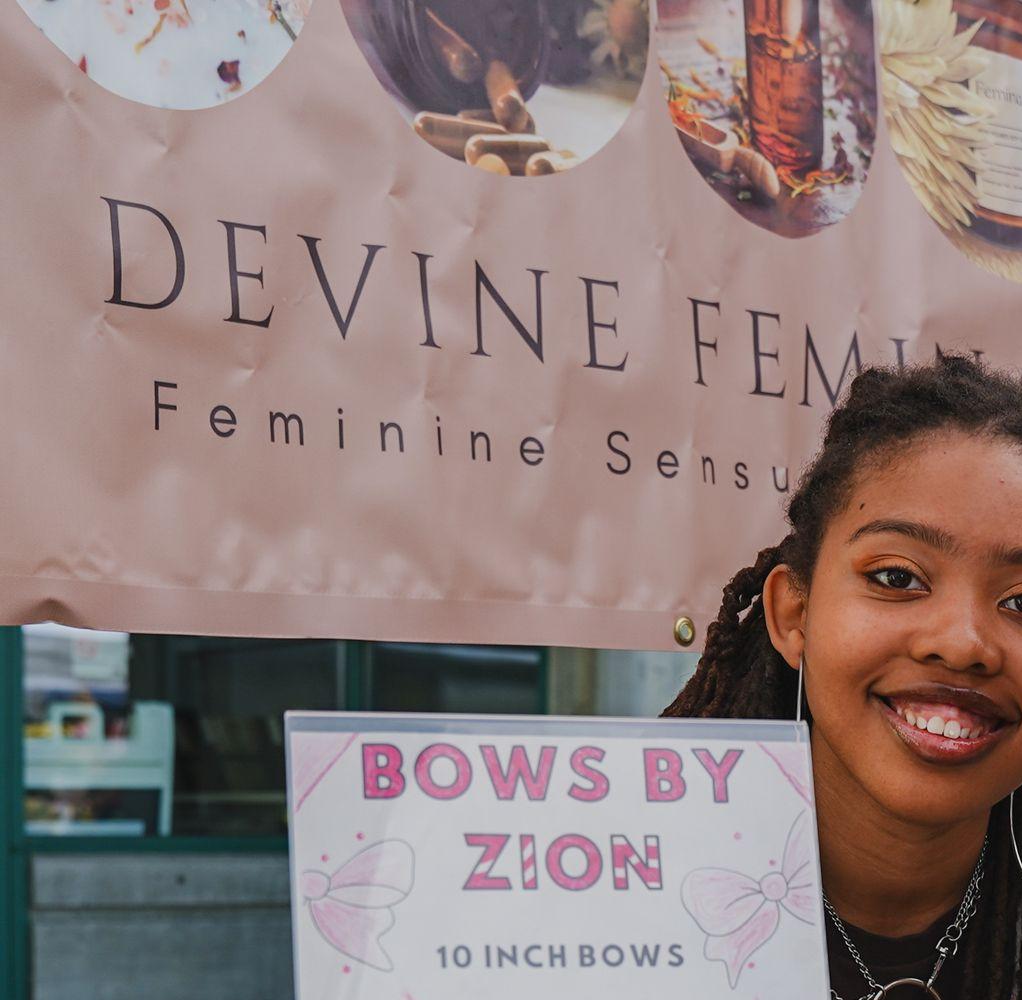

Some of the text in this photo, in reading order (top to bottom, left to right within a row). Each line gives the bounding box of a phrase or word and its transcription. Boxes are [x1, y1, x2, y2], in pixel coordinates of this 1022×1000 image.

[101, 196, 630, 372] DEVINE
[153, 380, 791, 493] Feminine Sensu
[361, 742, 745, 804] BOWS BY
[462, 833, 664, 891] ZION
[436, 942, 686, 969] 10 INCH BOWS
